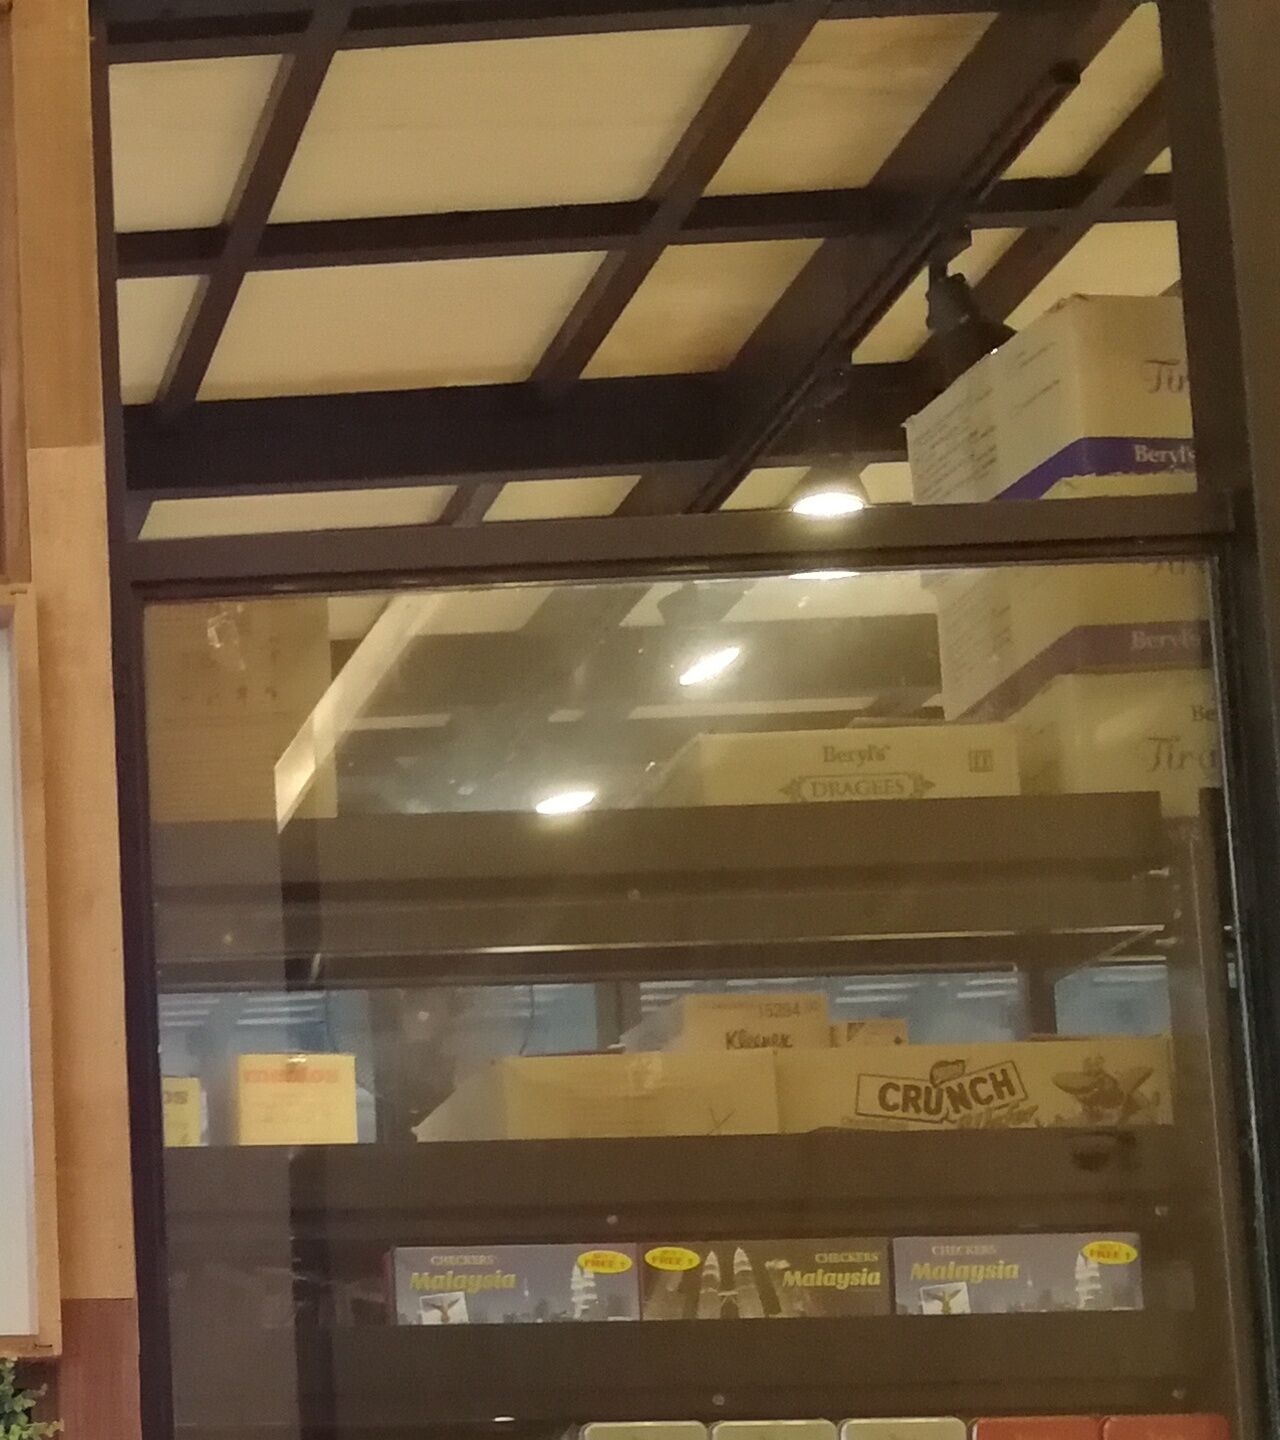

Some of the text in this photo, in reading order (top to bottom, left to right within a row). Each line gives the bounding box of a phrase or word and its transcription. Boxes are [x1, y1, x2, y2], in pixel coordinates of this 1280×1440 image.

[877, 1067, 1017, 1116] CRUNCH
[409, 1269, 518, 1295] Malaysia
[782, 1267, 882, 1291] Malaysia
[910, 1260, 1021, 1285] Malaysia
